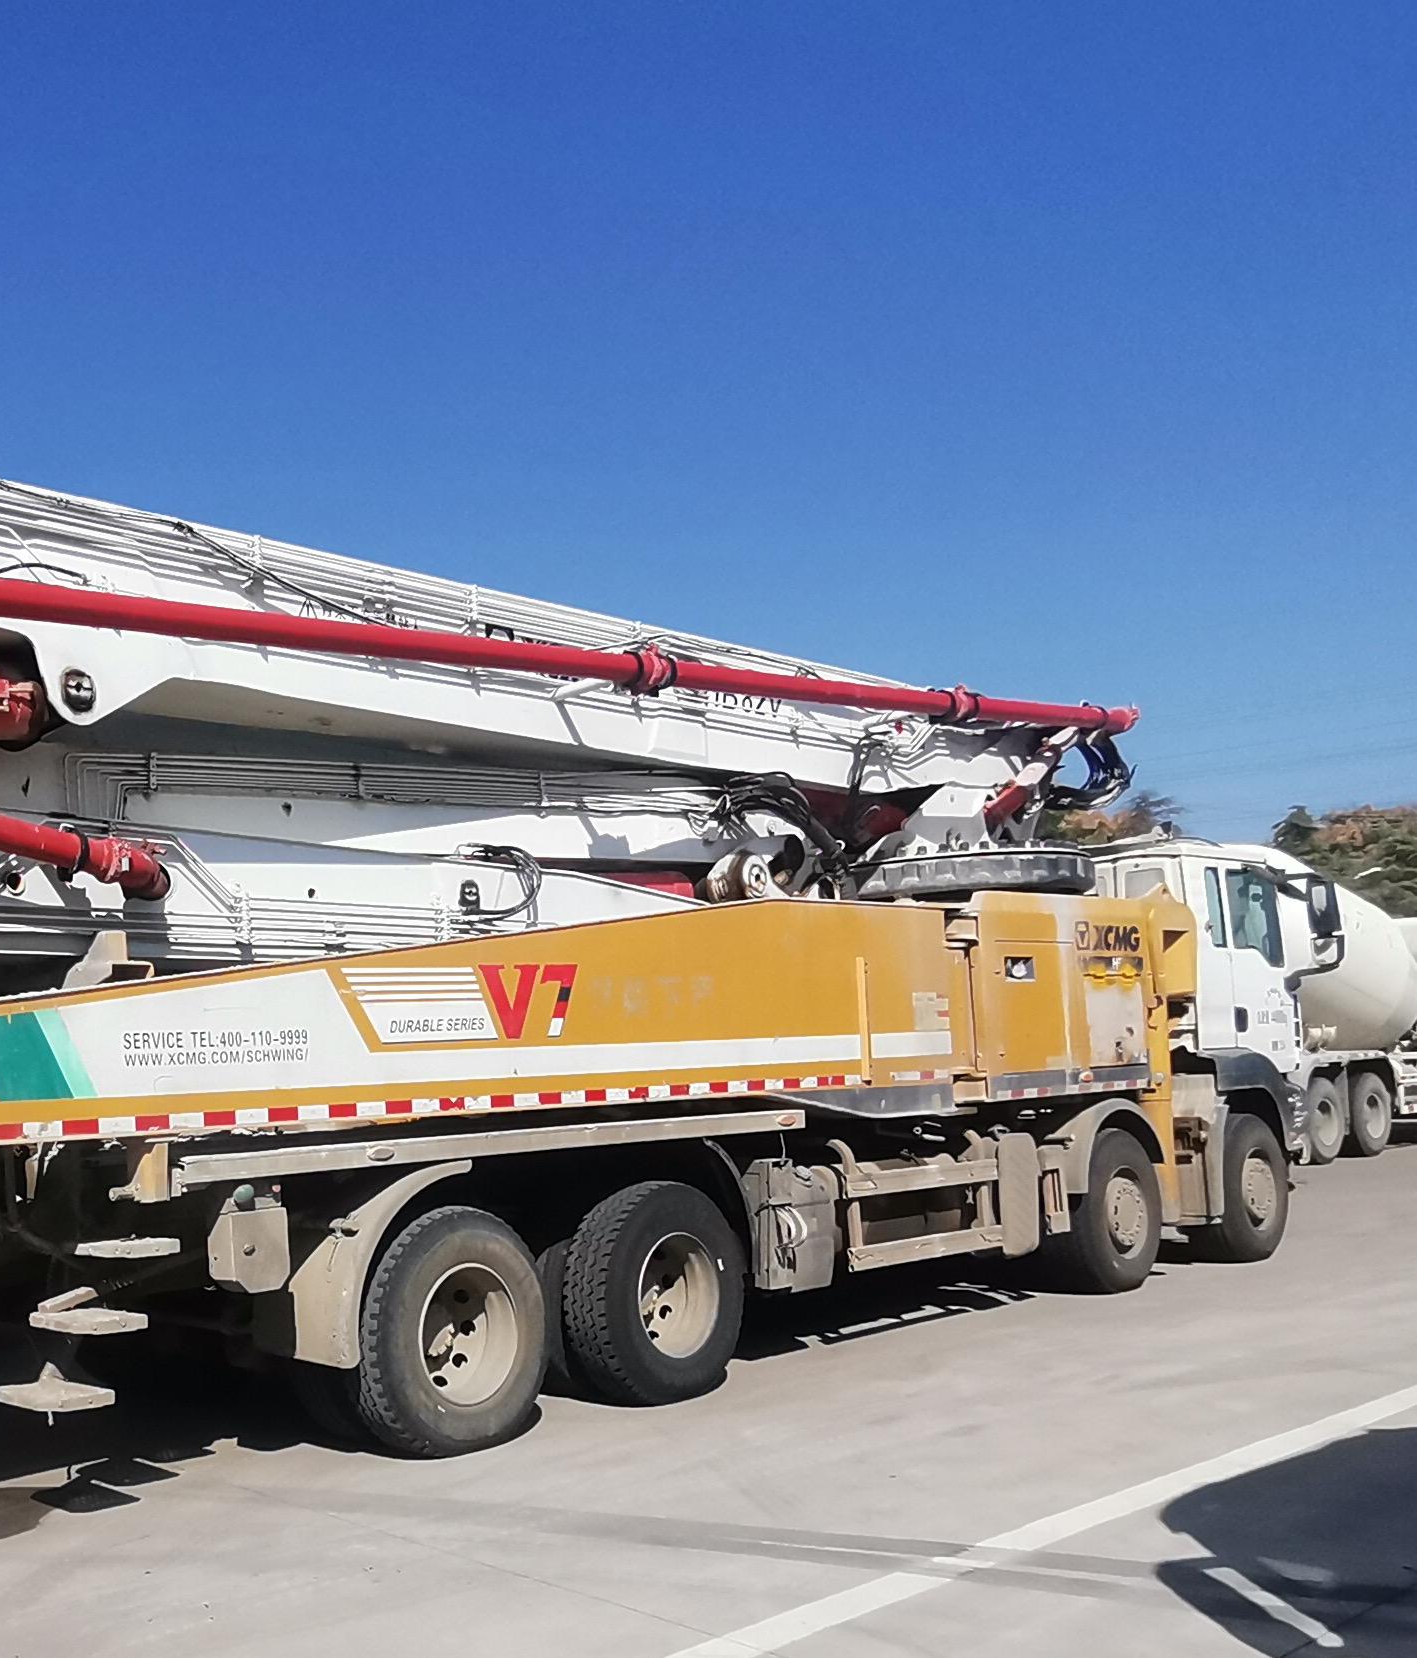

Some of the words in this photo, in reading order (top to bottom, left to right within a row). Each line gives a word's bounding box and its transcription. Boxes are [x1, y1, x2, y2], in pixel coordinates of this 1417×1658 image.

[1092, 924, 1141, 953] XCMG
[478, 963, 578, 1040] V7
[389, 1017, 444, 1034] DURABLE
[446, 1016, 485, 1032] SERIES
[122, 1031, 184, 1050] SERVICE
[190, 1028, 309, 1048] TEL:400-110-9999
[123, 1047, 310, 1067] WWW.XCMG.COM/SCHWING/
